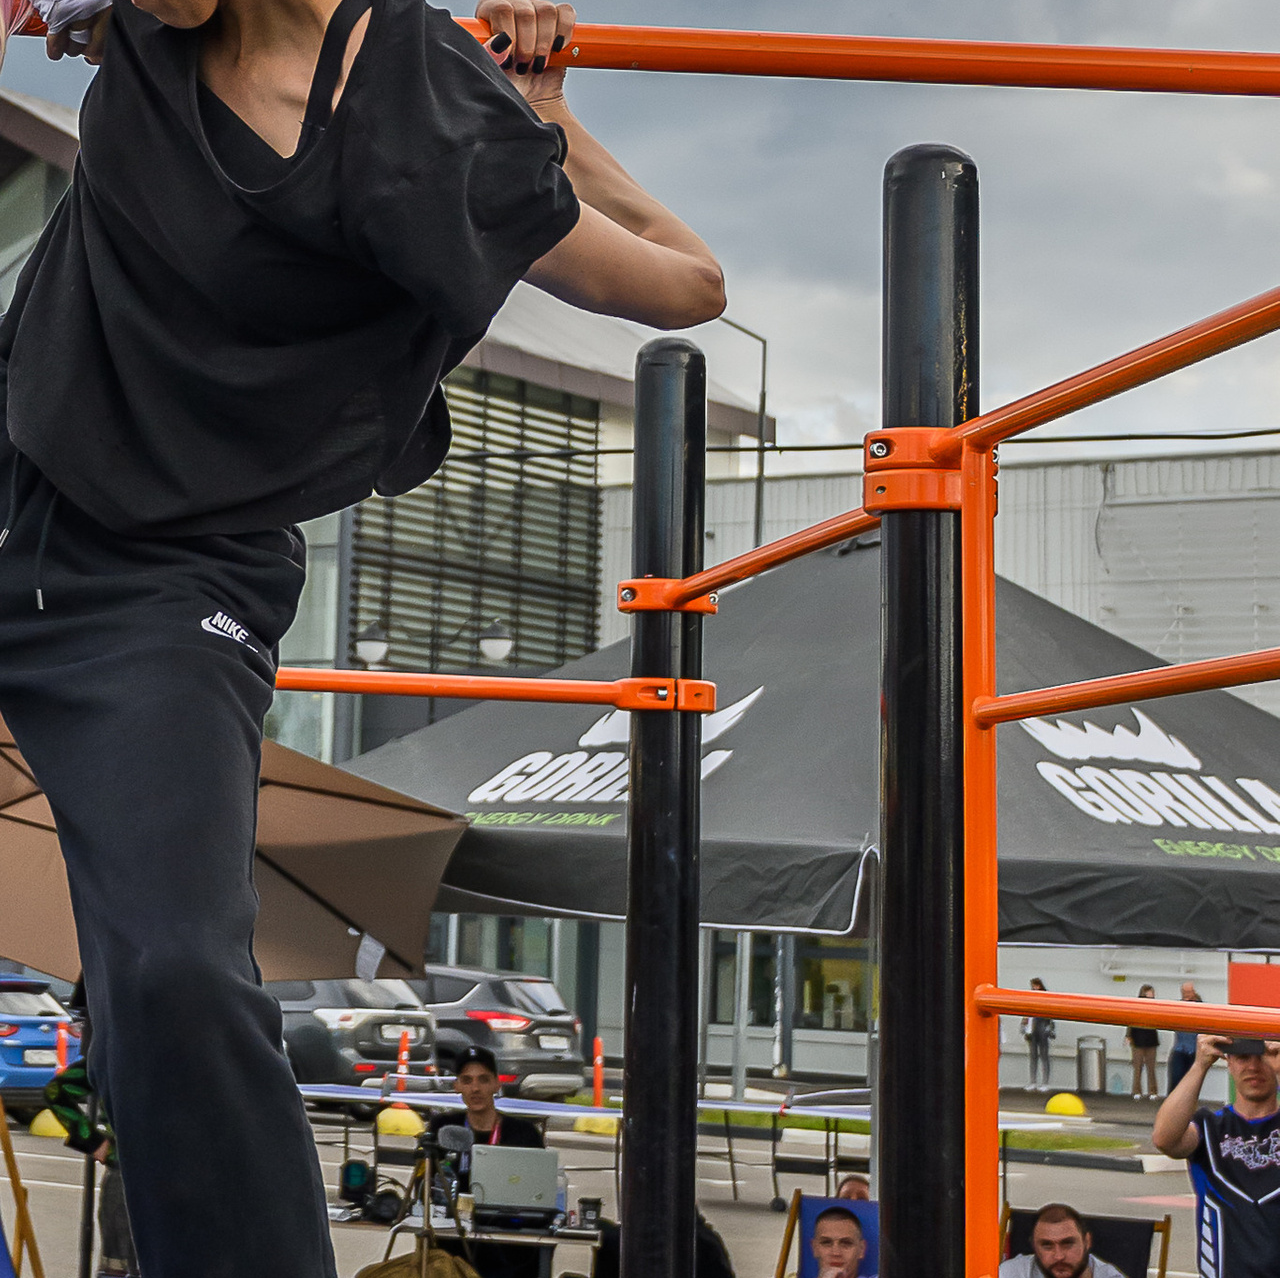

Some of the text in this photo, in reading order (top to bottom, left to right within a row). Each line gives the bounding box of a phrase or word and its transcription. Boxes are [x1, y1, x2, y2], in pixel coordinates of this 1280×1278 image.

[211, 611, 249, 642] NIKE
[467, 750, 733, 803] GORIL
[542, 812, 622, 826] DRINK
